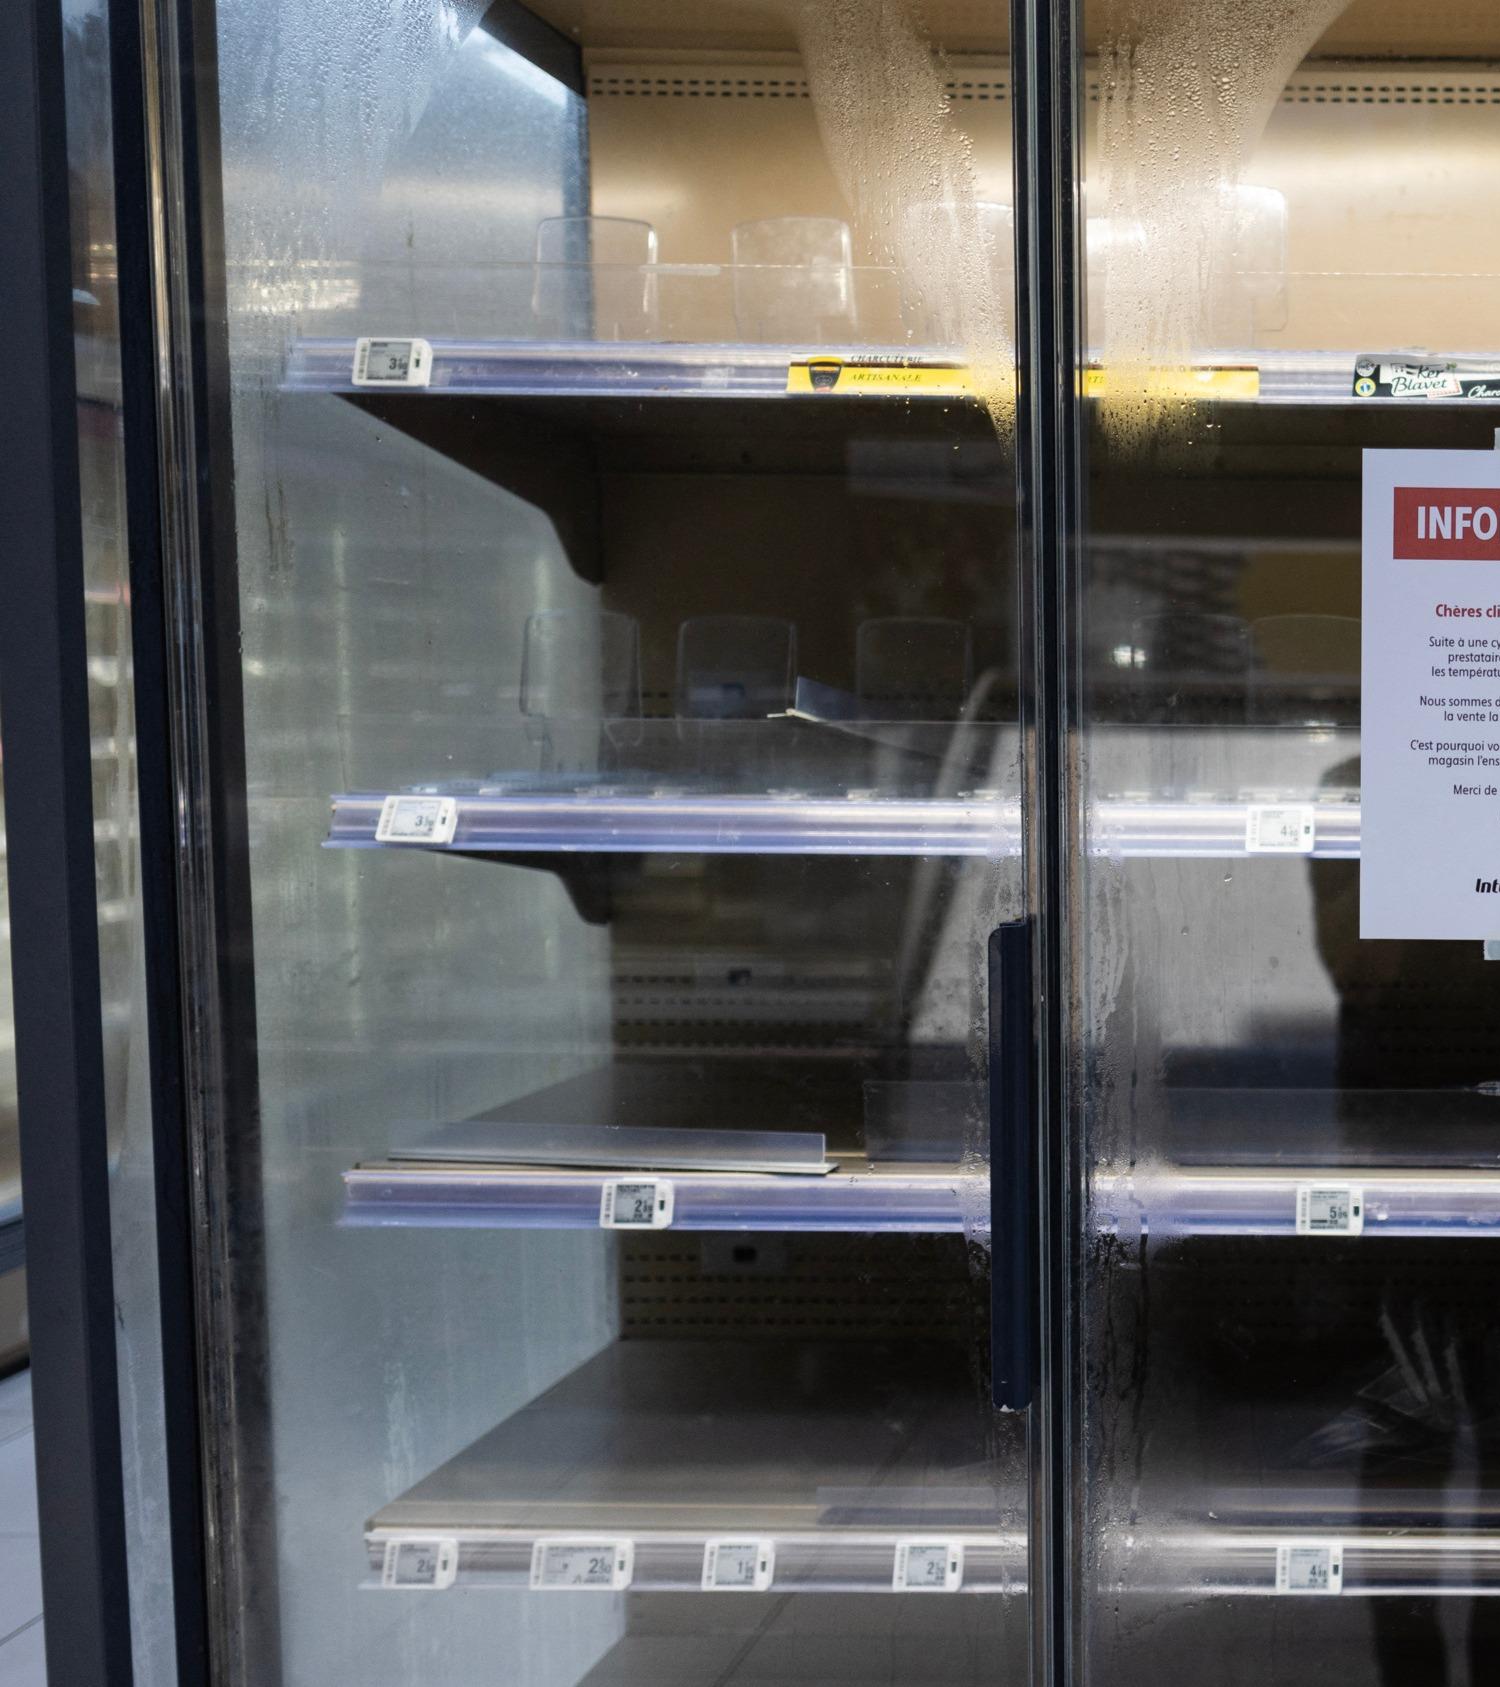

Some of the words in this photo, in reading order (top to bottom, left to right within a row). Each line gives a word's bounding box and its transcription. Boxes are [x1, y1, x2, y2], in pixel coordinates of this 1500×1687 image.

[1417, 365, 1444, 379] Ker
[1392, 376, 1447, 392] Blavet
[1436, 604, 1482, 617] Chères
[1429, 636, 1455, 647] Suite
[1457, 637, 1465, 647] à
[1431, 666, 1446, 677] les
[1419, 696, 1447, 706] Nous
[1449, 699, 1492, 707] sommes
[1443, 711, 1454, 721] la
[1457, 712, 1486, 721] vente
[1488, 711, 1499, 722] la
[1436, 741, 1484, 754] pourquoi
[1429, 755, 1474, 768] magasin
[1453, 784, 1481, 795] Merci
[1483, 785, 1498, 795] de
